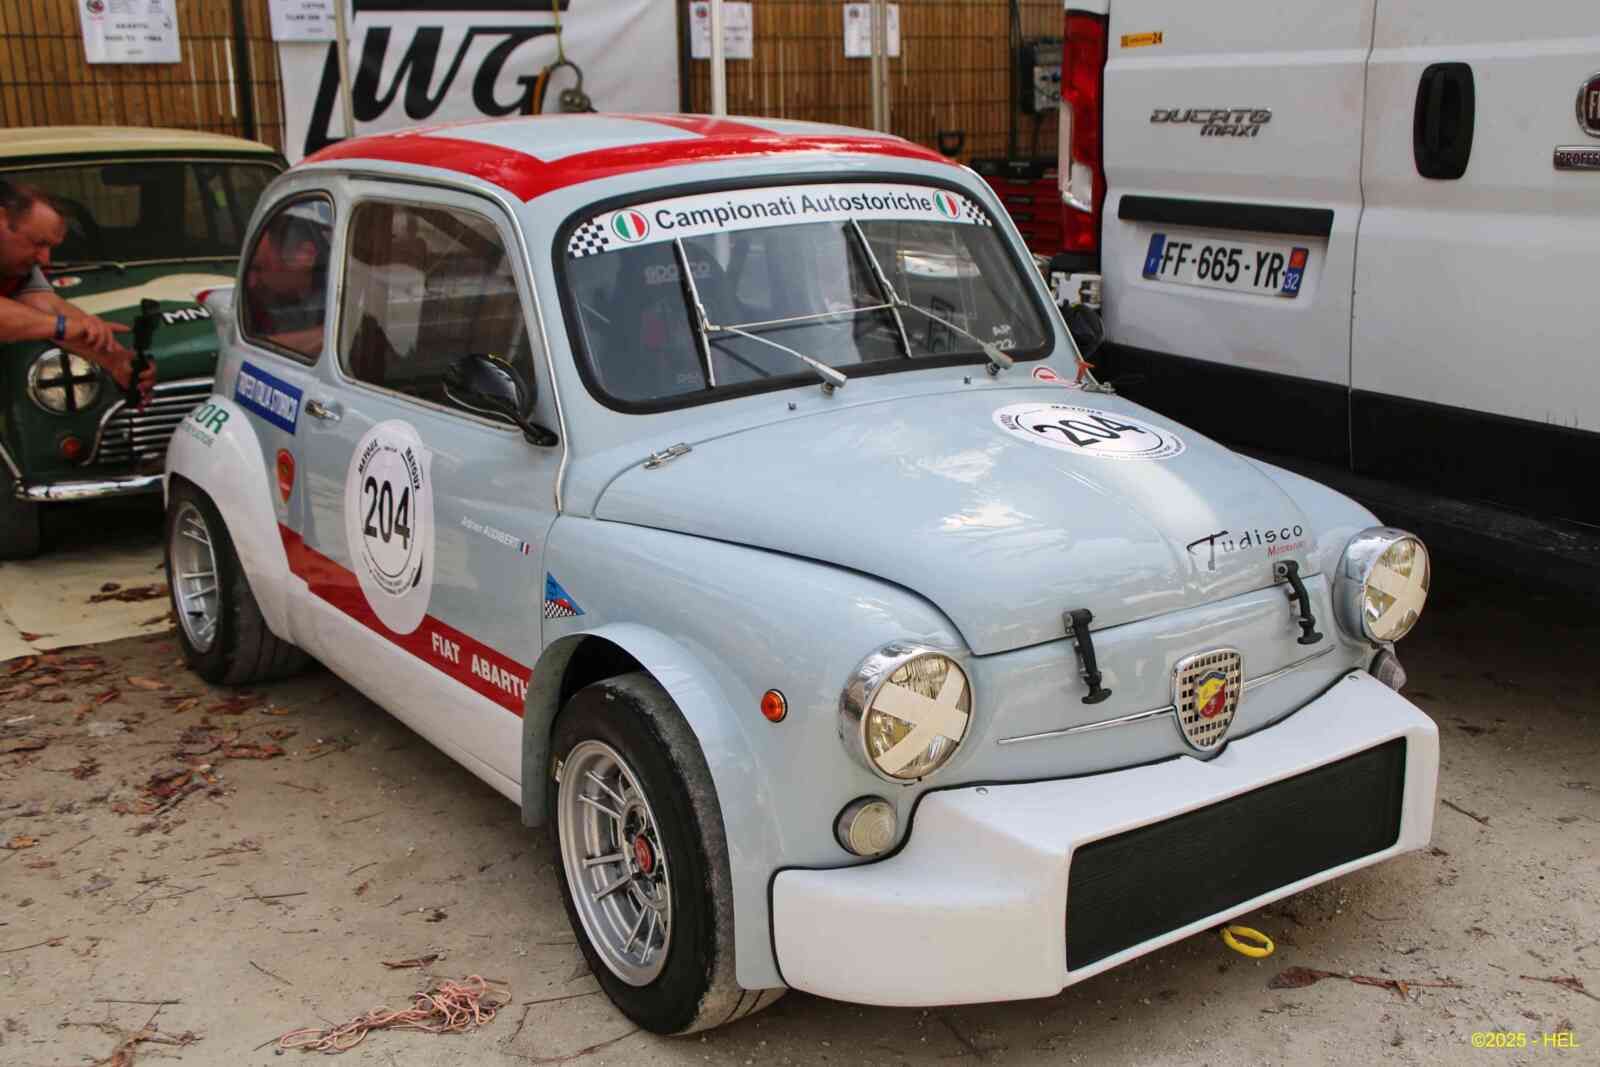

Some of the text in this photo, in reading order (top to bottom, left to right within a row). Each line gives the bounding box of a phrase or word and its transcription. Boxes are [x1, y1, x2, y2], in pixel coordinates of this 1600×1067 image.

[1150, 108, 1272, 124] DUCATO
[1200, 123, 1261, 137] MAXI
[655, 191, 932, 230] Campionati Autostoriche
[1160, 241, 1286, 289] FF-665-YR
[1284, 272, 1300, 290] 32
[1032, 415, 1146, 448] 204
[363, 475, 411, 551] 204
[1186, 524, 1303, 571] Tudisco
[431, 631, 460, 665] FIAT
